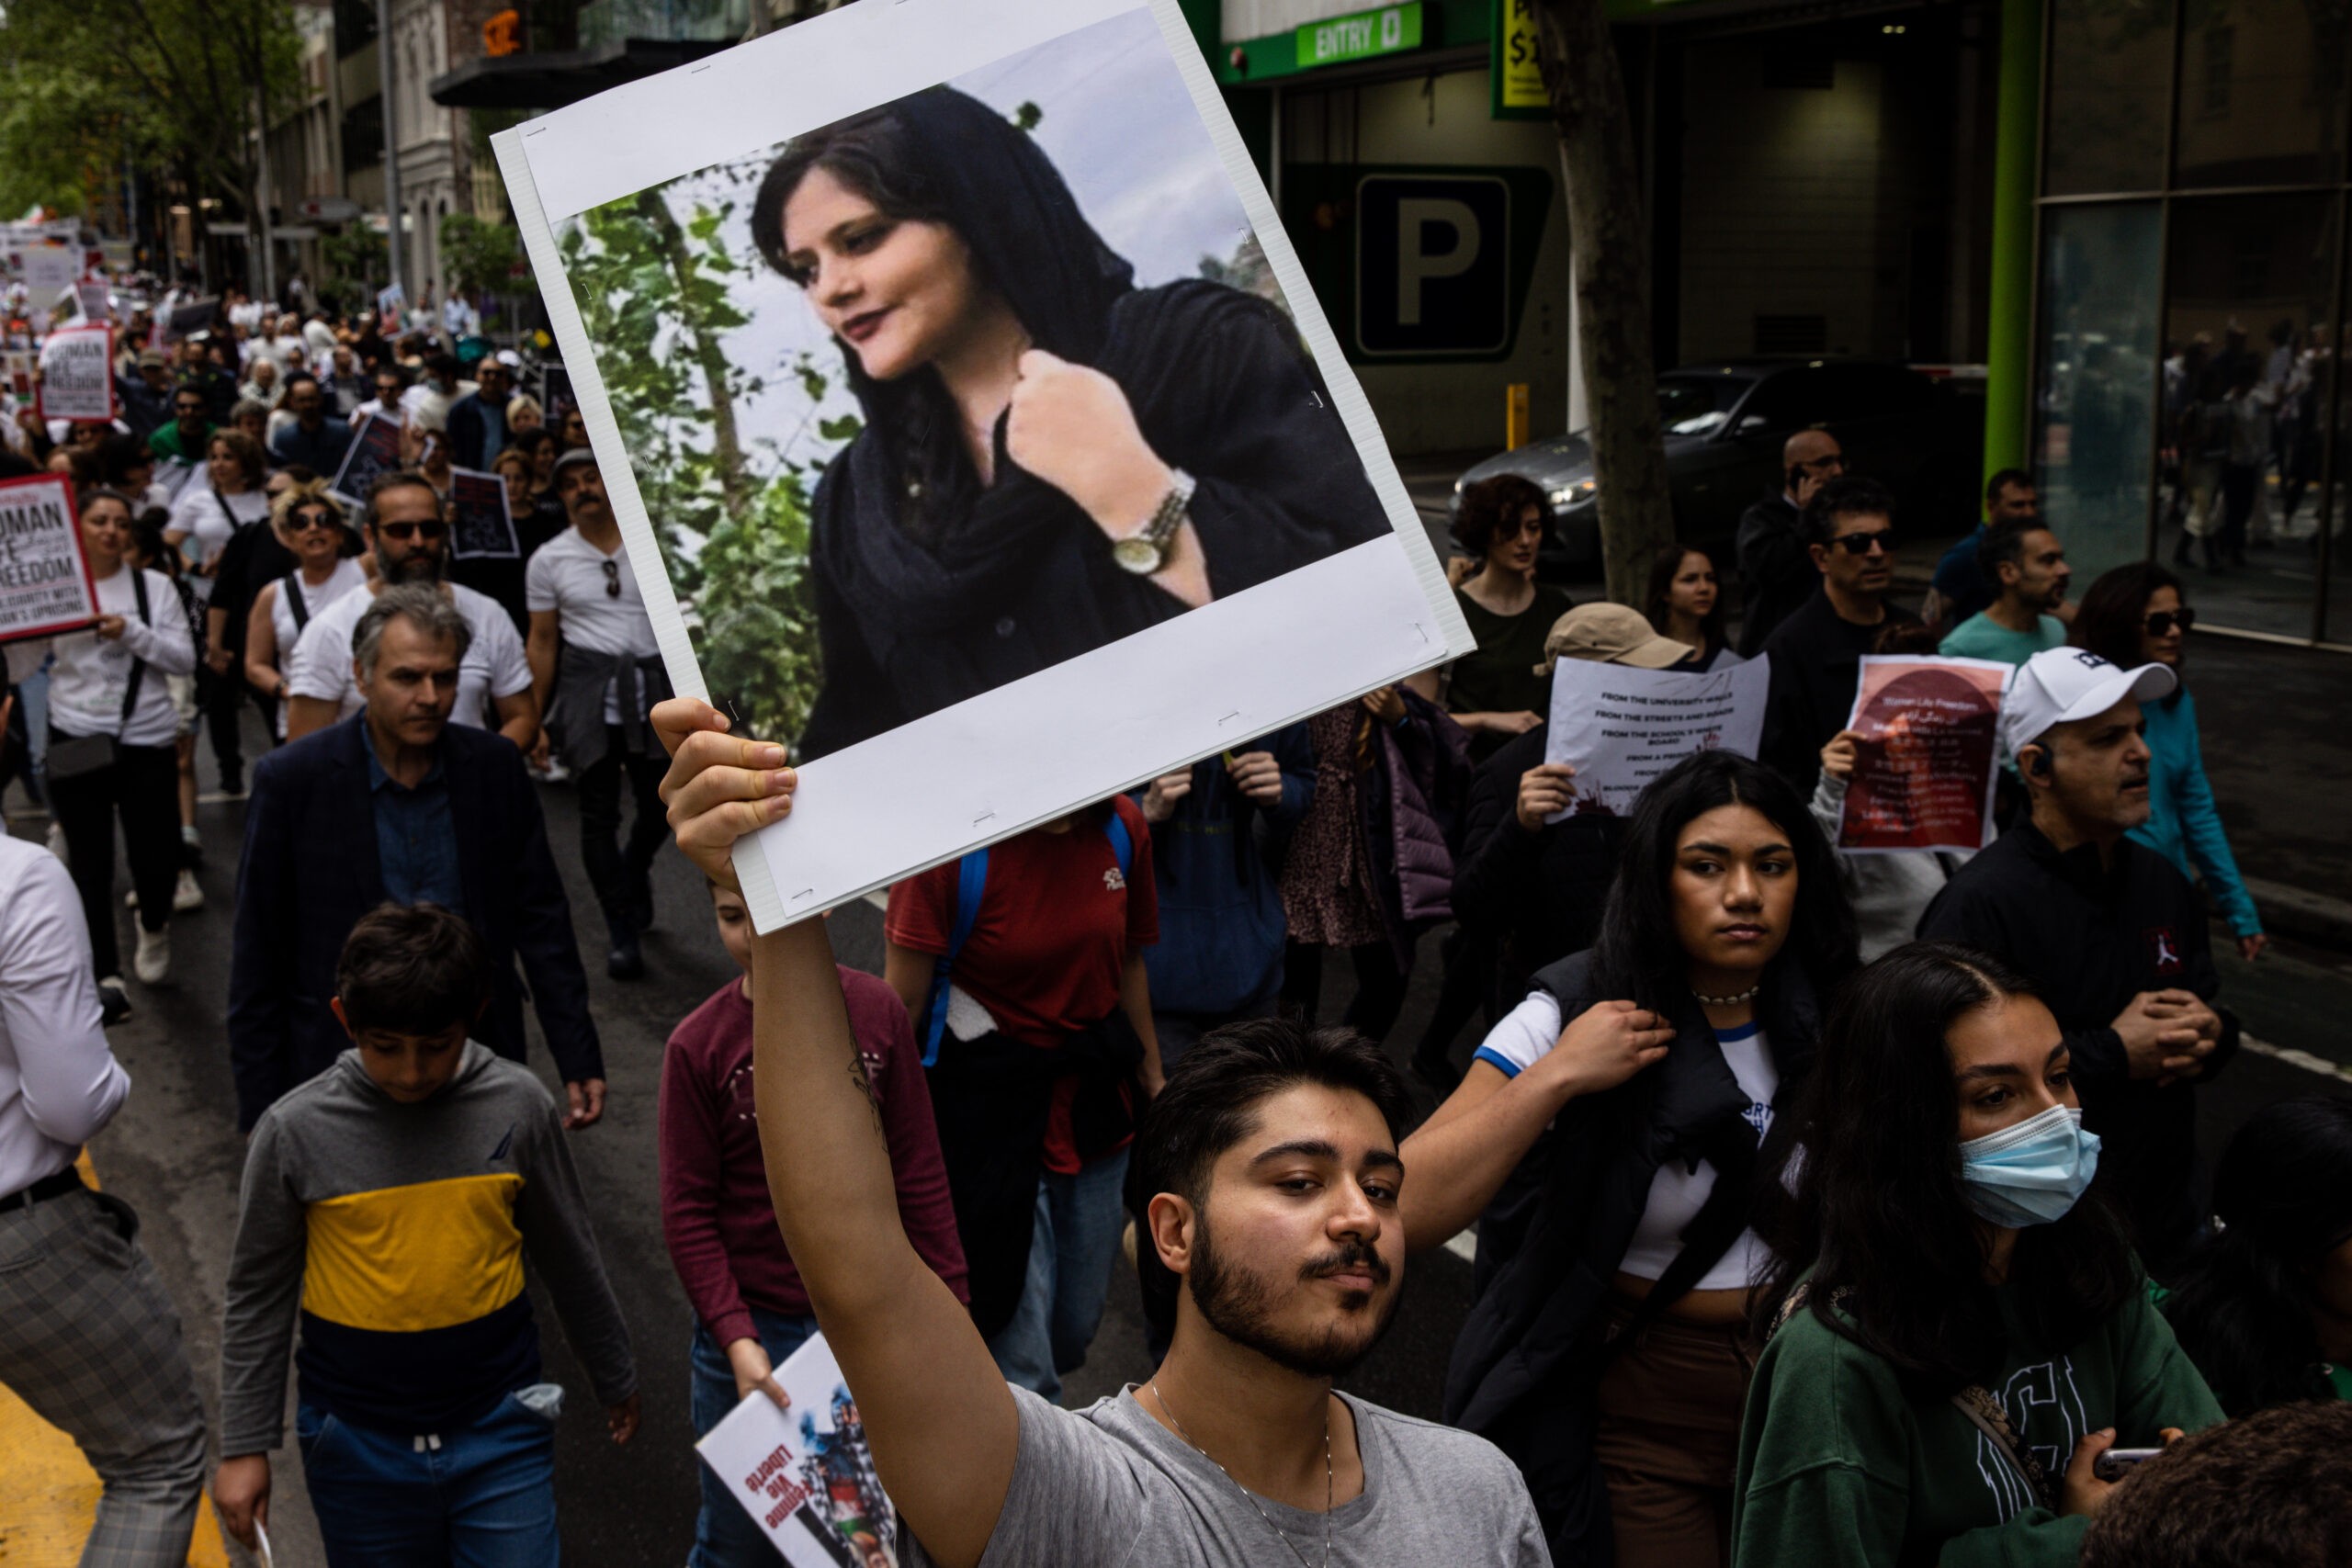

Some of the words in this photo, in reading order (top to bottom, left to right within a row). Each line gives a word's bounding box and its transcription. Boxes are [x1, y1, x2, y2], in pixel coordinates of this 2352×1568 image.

[1316, 17, 1374, 59] ENTRY
[1397, 197, 1481, 326] P
[1601, 692, 1628, 702] FROM
[1630, 695, 1647, 705] THE
[1650, 696, 1703, 705] UNIVERSITY
[1595, 710, 1622, 720] FROM
[1623, 713, 1642, 722] THE
[1601, 728, 1629, 739] FROM
[1647, 738, 1680, 746] BOARD
[745, 1444, 794, 1496] Liberté
[766, 1473, 795, 1499] Vie
[765, 1479, 814, 1529] Femme
